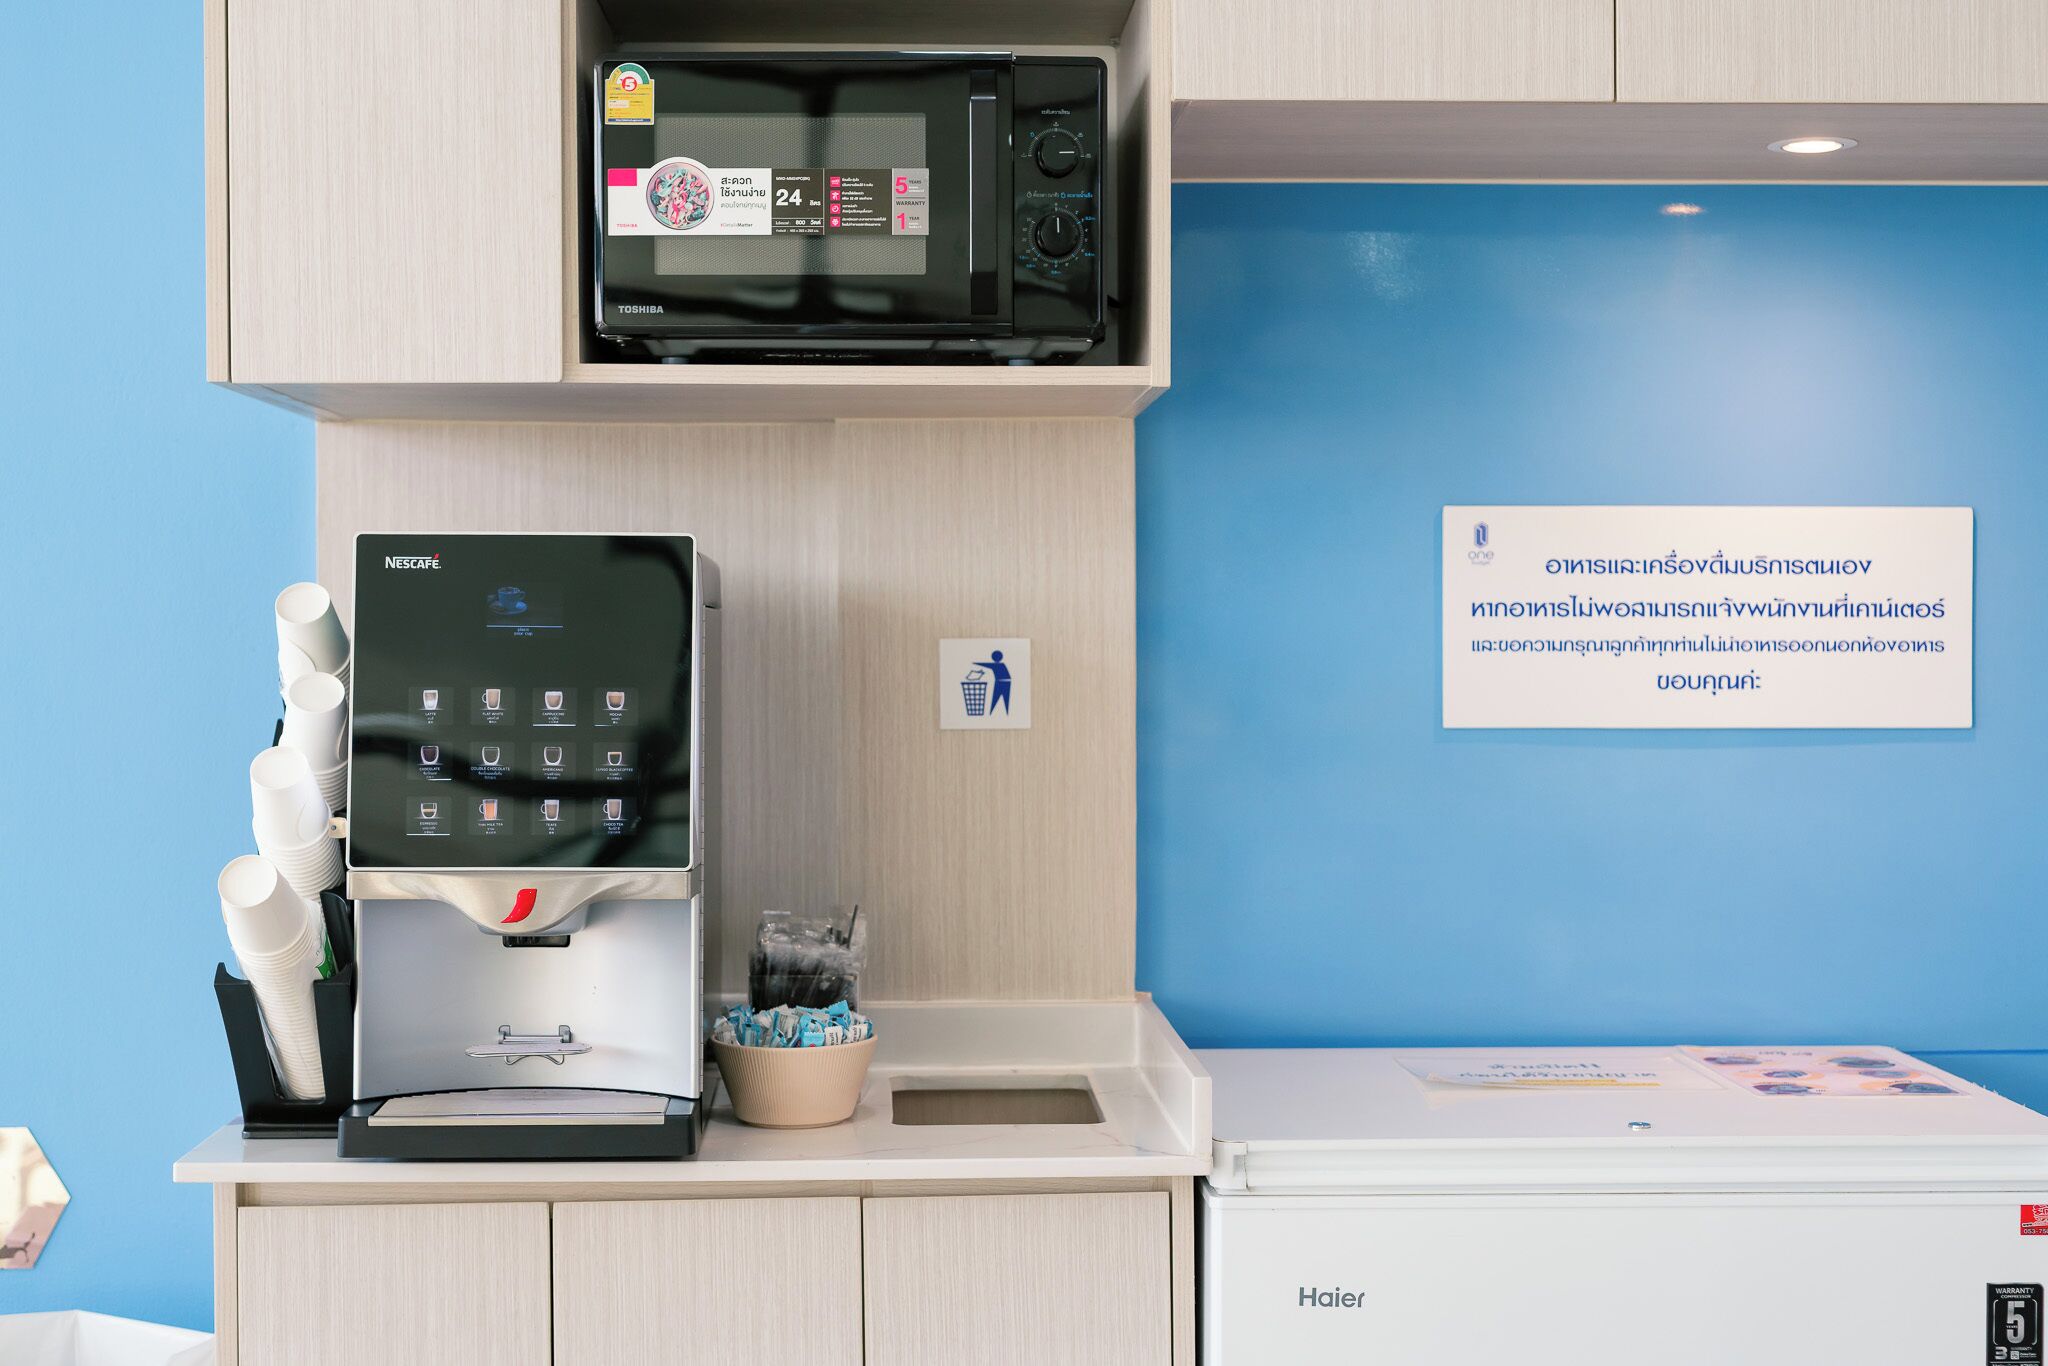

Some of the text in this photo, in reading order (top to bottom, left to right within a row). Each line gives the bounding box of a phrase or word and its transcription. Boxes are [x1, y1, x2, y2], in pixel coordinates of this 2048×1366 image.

[624, 78, 635, 91] 5
[720, 176, 752, 186] สะดวก
[896, 176, 908, 194] 5
[720, 186, 766, 198] ใช้งานง่าย
[776, 188, 802, 206] 24
[896, 212, 906, 230] 1
[618, 304, 664, 314] TOSHIBA
[385, 552, 442, 570] NESCAFÉ
[1468, 550, 1494, 560] one
[1546, 549, 1872, 576] อาหารและเครื่องดื่มบริการตนเอง
[1470, 593, 1946, 619] หากอาหารไม่พอสามารถแจ้งพนักงานที่เคาน์เตอร์
[1656, 670, 1762, 696] ขอบคุณค่ะ
[1298, 1286, 1366, 1308] Haier
[2006, 1300, 2025, 1344] 5
[1994, 1346, 2008, 1360] 3
